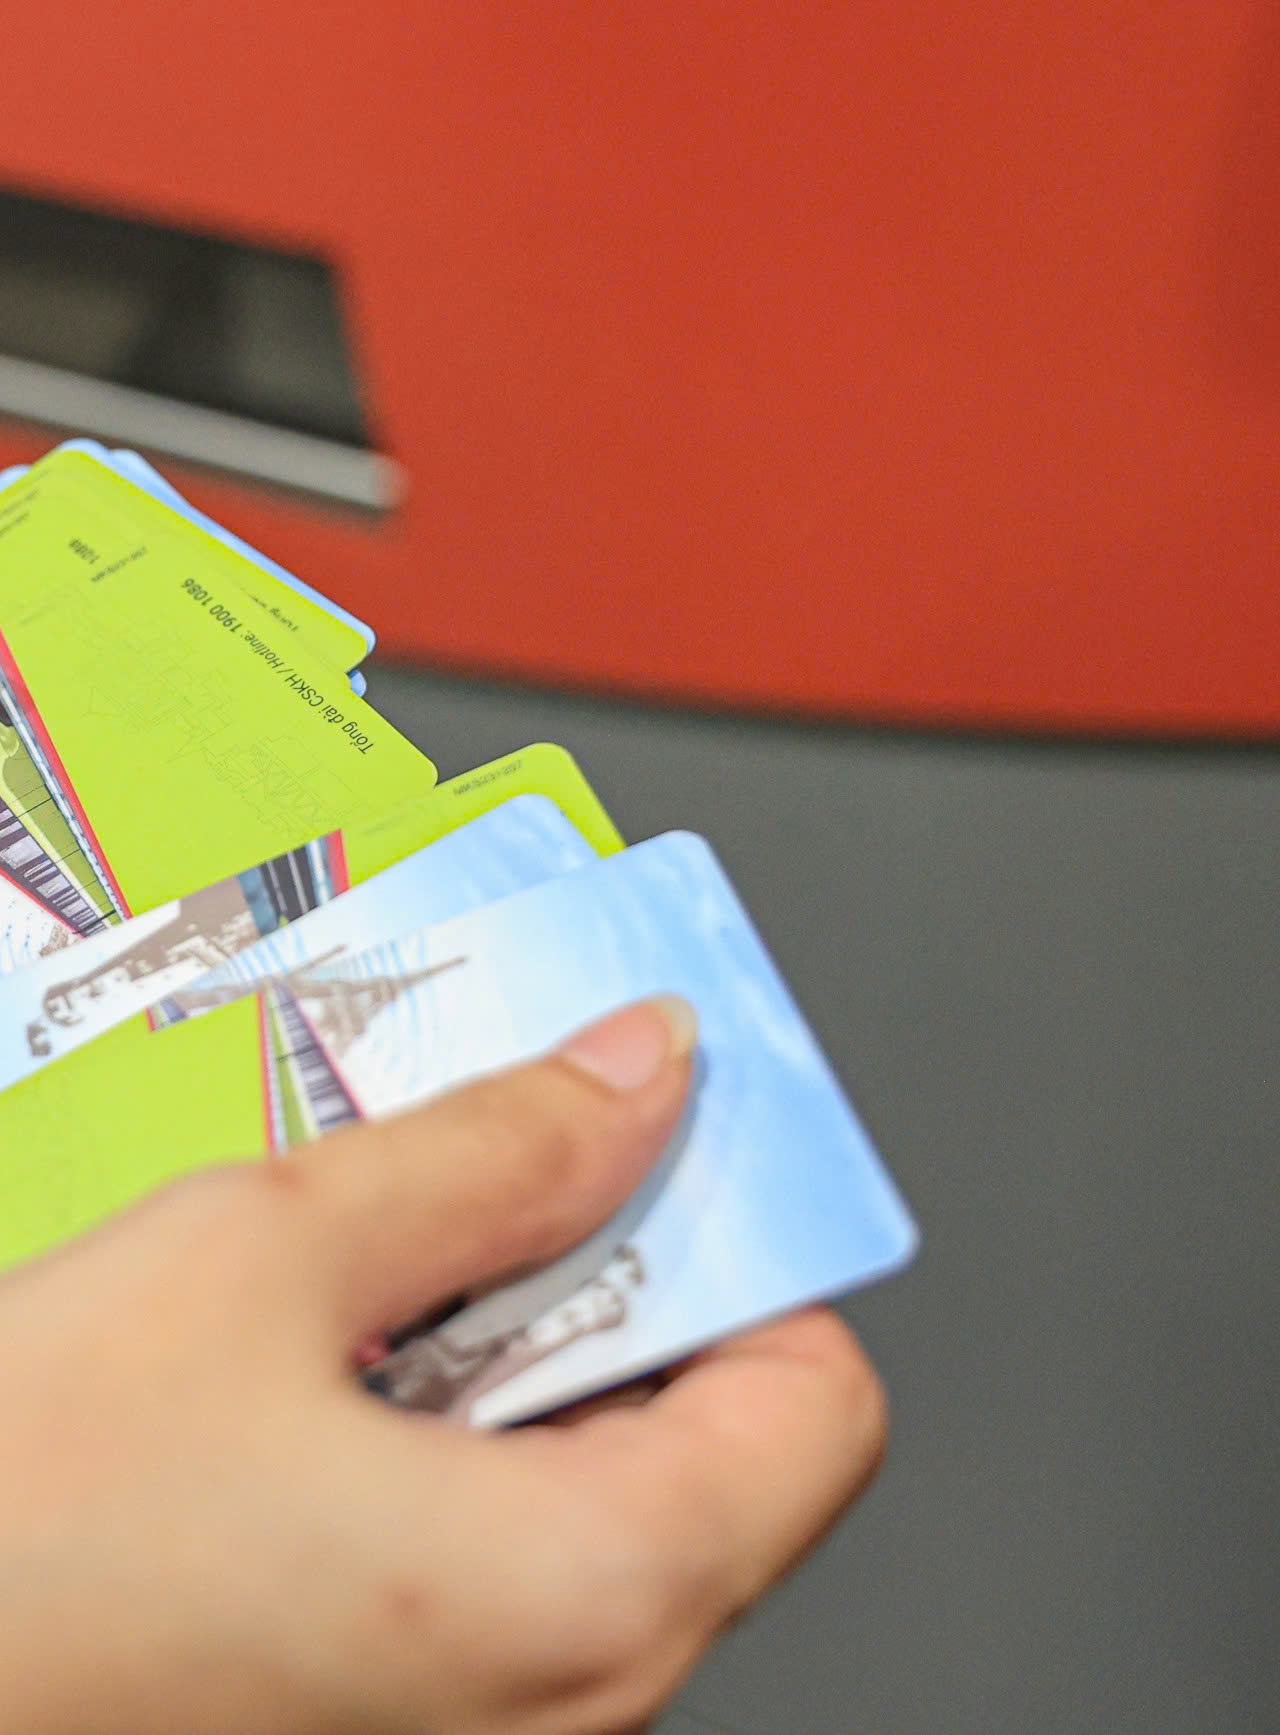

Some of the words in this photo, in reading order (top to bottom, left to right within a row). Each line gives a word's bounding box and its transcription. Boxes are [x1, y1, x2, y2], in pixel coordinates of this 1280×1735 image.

[181, 577, 213, 606] 1086
[209, 604, 242, 633] 1900
[240, 631, 284, 669] Hotline:
[284, 673, 324, 707] CSKH
[318, 704, 345, 724] đài
[342, 722, 374, 755] Tổng
